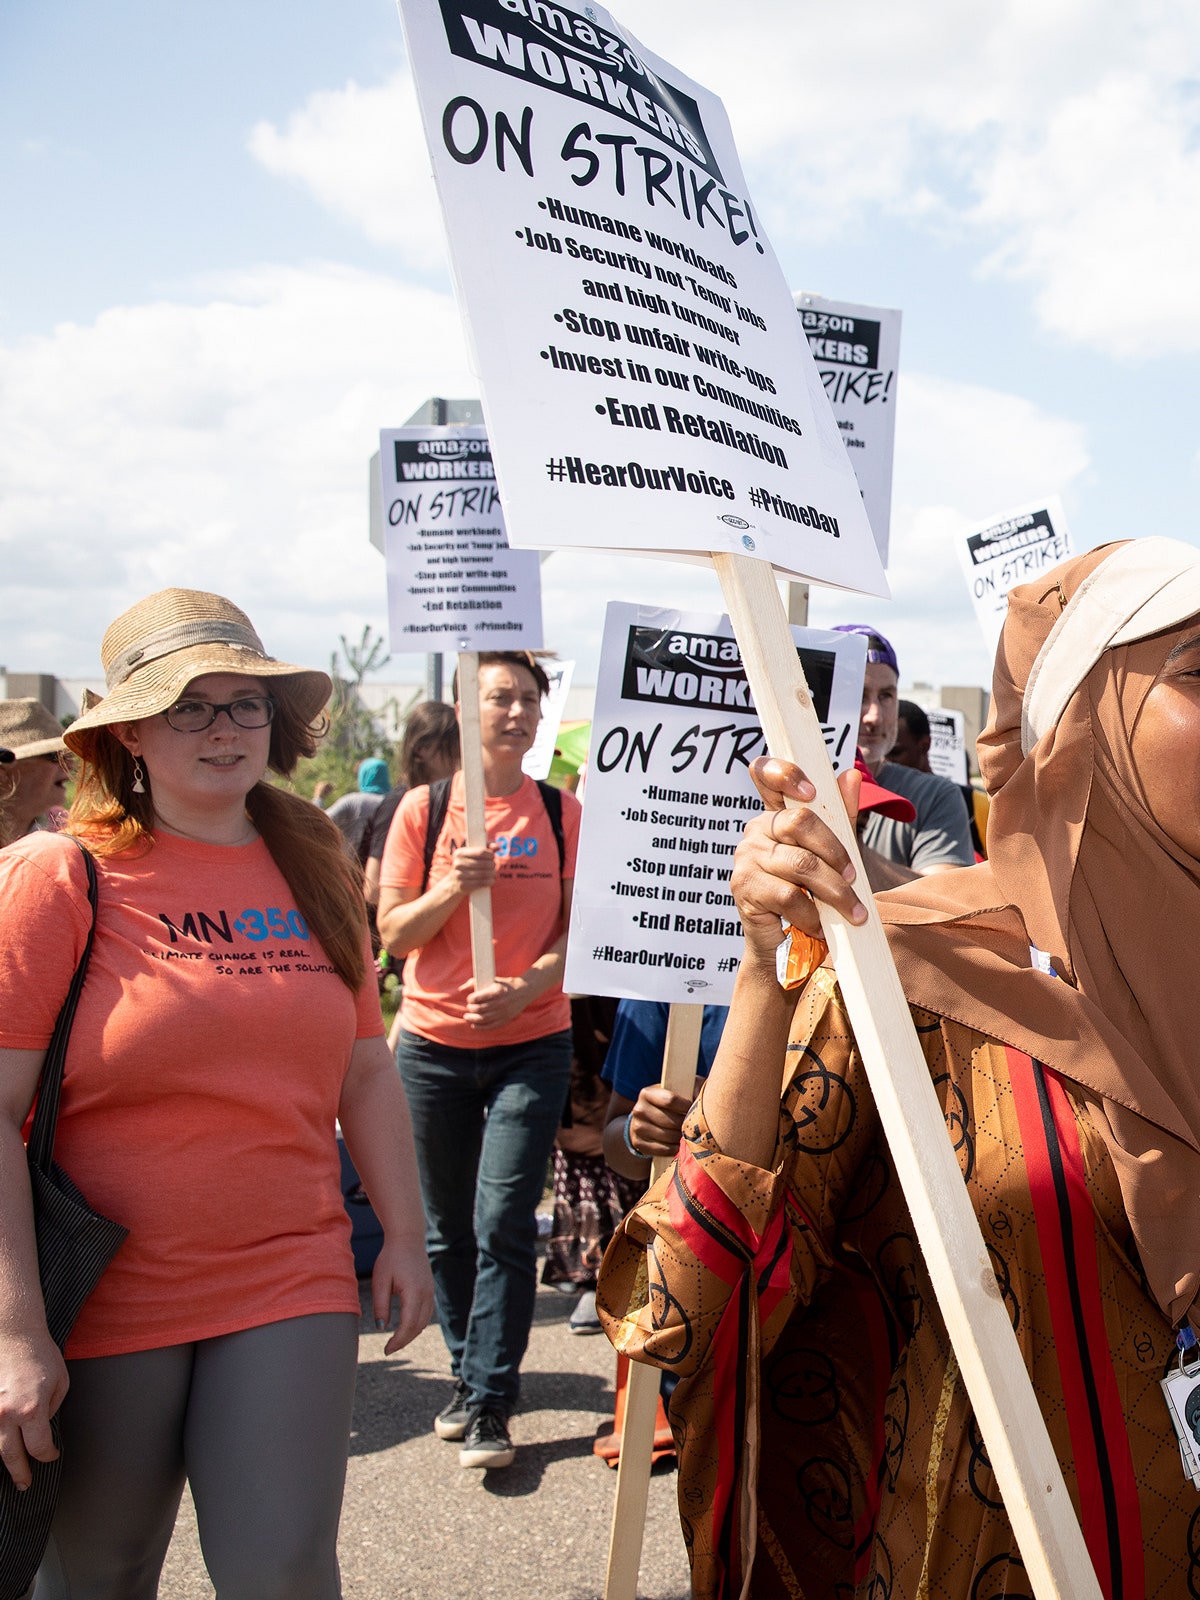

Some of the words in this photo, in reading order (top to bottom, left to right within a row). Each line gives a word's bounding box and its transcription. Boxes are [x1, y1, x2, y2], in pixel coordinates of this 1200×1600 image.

[461, 14, 706, 165] WORKERS
[442, 95, 534, 178] ON
[561, 122, 765, 255] STRIKE!
[643, 229, 738, 289] workloads
[564, 237, 653, 280] Security
[654, 263, 686, 291] not
[734, 303, 768, 332] jobs
[582, 278, 624, 303] and
[624, 285, 671, 315] high
[671, 301, 741, 346] turnover
[799, 310, 855, 334] azon
[624, 323, 691, 358] unfair
[692, 343, 777, 395] write-ups
[808, 335, 870, 366] KERS
[627, 359, 651, 384] in
[655, 367, 691, 393] our
[692, 374, 803, 437] Communities
[819, 371, 894, 405] RIKE!
[663, 405, 789, 470] Retaliation
[402, 460, 496, 481] WORKER
[388, 494, 423, 526] ON
[430, 486, 502, 520] STRIK
[546, 456, 736, 501] #HearOurVoice
[748, 486, 841, 538] #PrimeDay
[974, 569, 995, 599] ON
[1002, 533, 1070, 585] STRIKE!
[636, 667, 756, 708] WORK
[597, 722, 663, 774] ON
[650, 810, 706, 830] Security
[708, 818, 730, 832] not
[495, 836, 538, 858] 350
[651, 836, 676, 850] and
[679, 837, 708, 854] high
[669, 862, 714, 880] unfair
[661, 886, 675, 901] in
[678, 890, 702, 904] our
[208, 951, 257, 961] CHANGE
[262, 950, 275, 960] IS
[216, 965, 234, 975] SO
[239, 965, 264, 975] ARE
[267, 963, 292, 974] THE
[593, 946, 706, 970] #HearOurVoice
